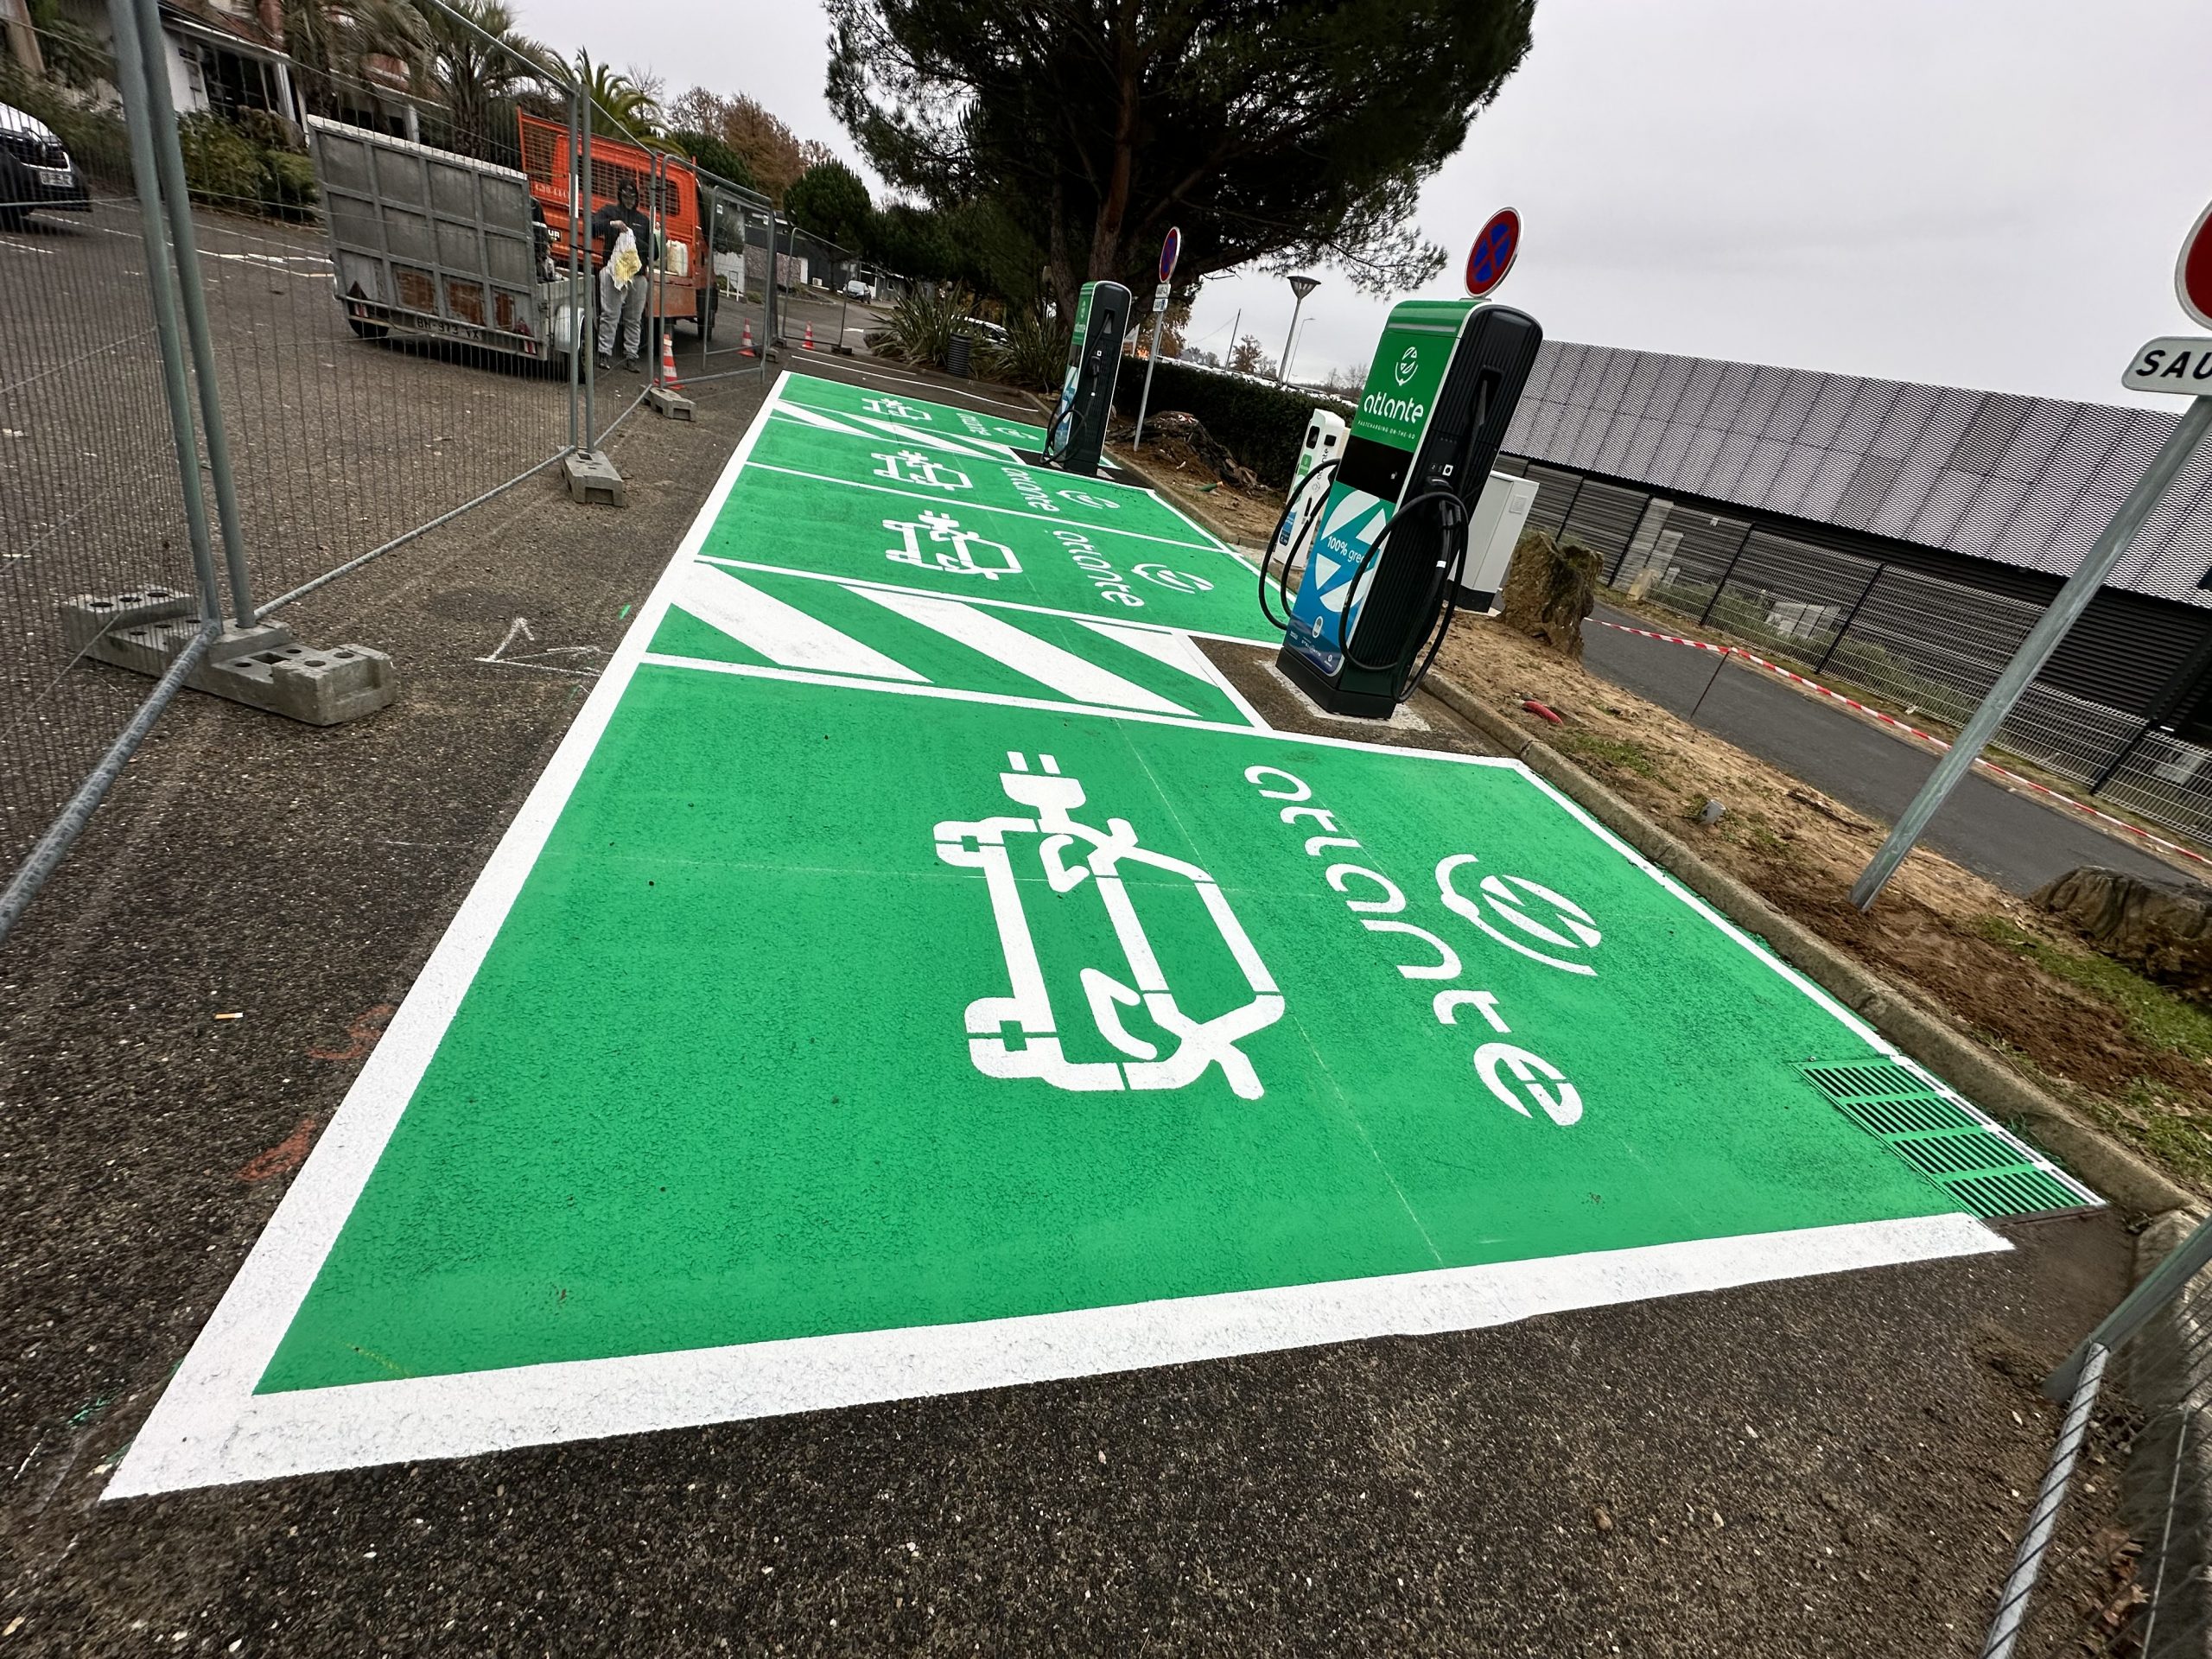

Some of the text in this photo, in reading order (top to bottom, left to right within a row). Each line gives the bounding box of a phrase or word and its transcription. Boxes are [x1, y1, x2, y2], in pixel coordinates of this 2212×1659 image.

[1363, 391, 1424, 423] atlante
[1052, 530, 1145, 607] atlante
[1327, 536, 1371, 569] 100% gre
[1244, 766, 1584, 1127] atlante
